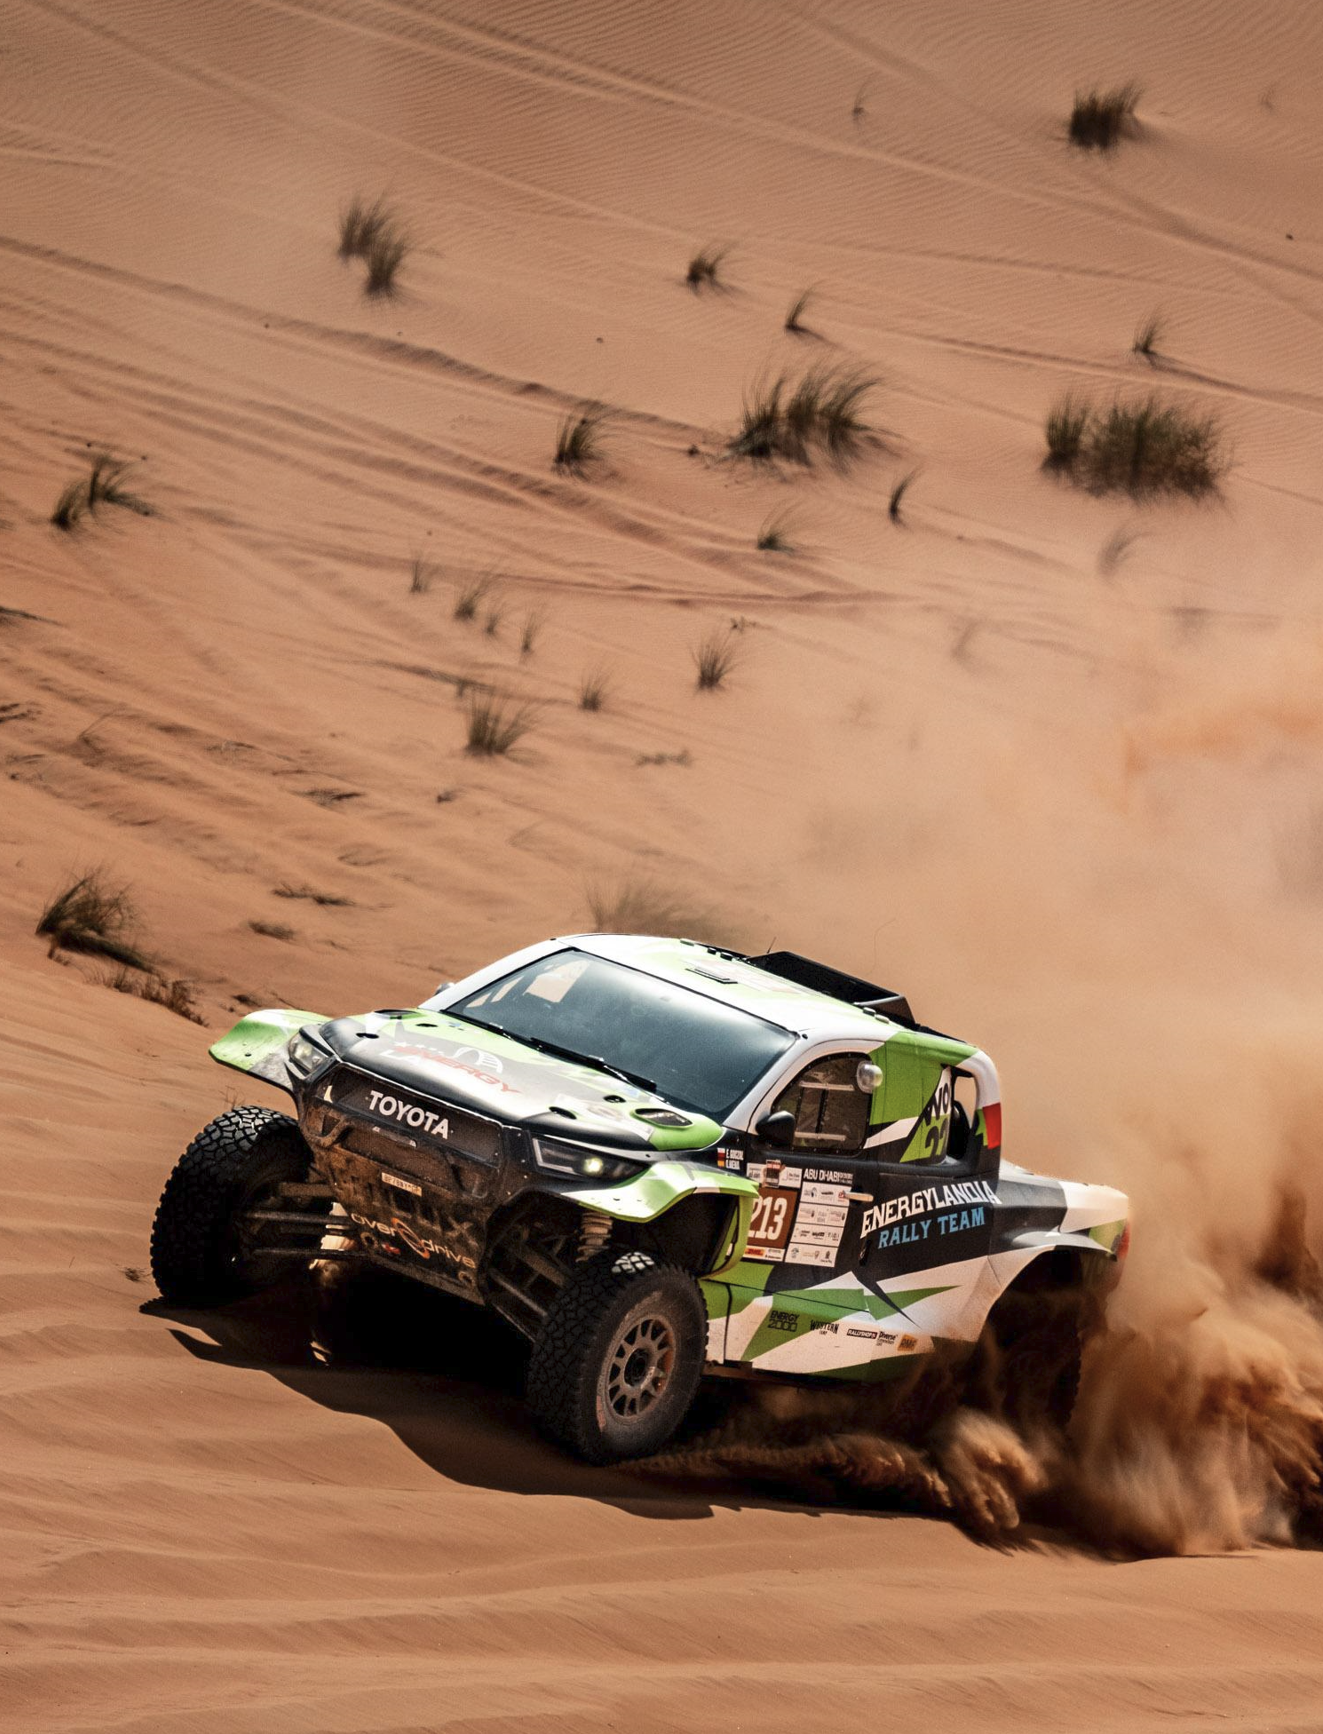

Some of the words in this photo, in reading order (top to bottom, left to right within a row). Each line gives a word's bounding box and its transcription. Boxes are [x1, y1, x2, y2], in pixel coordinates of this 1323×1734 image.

[368, 1089, 450, 1140] TOYOTA
[803, 1168, 819, 1181] ABU
[819, 1169, 840, 1183] DHABI
[748, 1195, 787, 1241] 213
[860, 1180, 1002, 1239] ENERGYLANDIA
[878, 1219, 932, 1249] RALLY
[937, 1206, 985, 1236] TEAM
[767, 1318, 798, 1332] 2000
[769, 1309, 800, 1323] ENERGY
